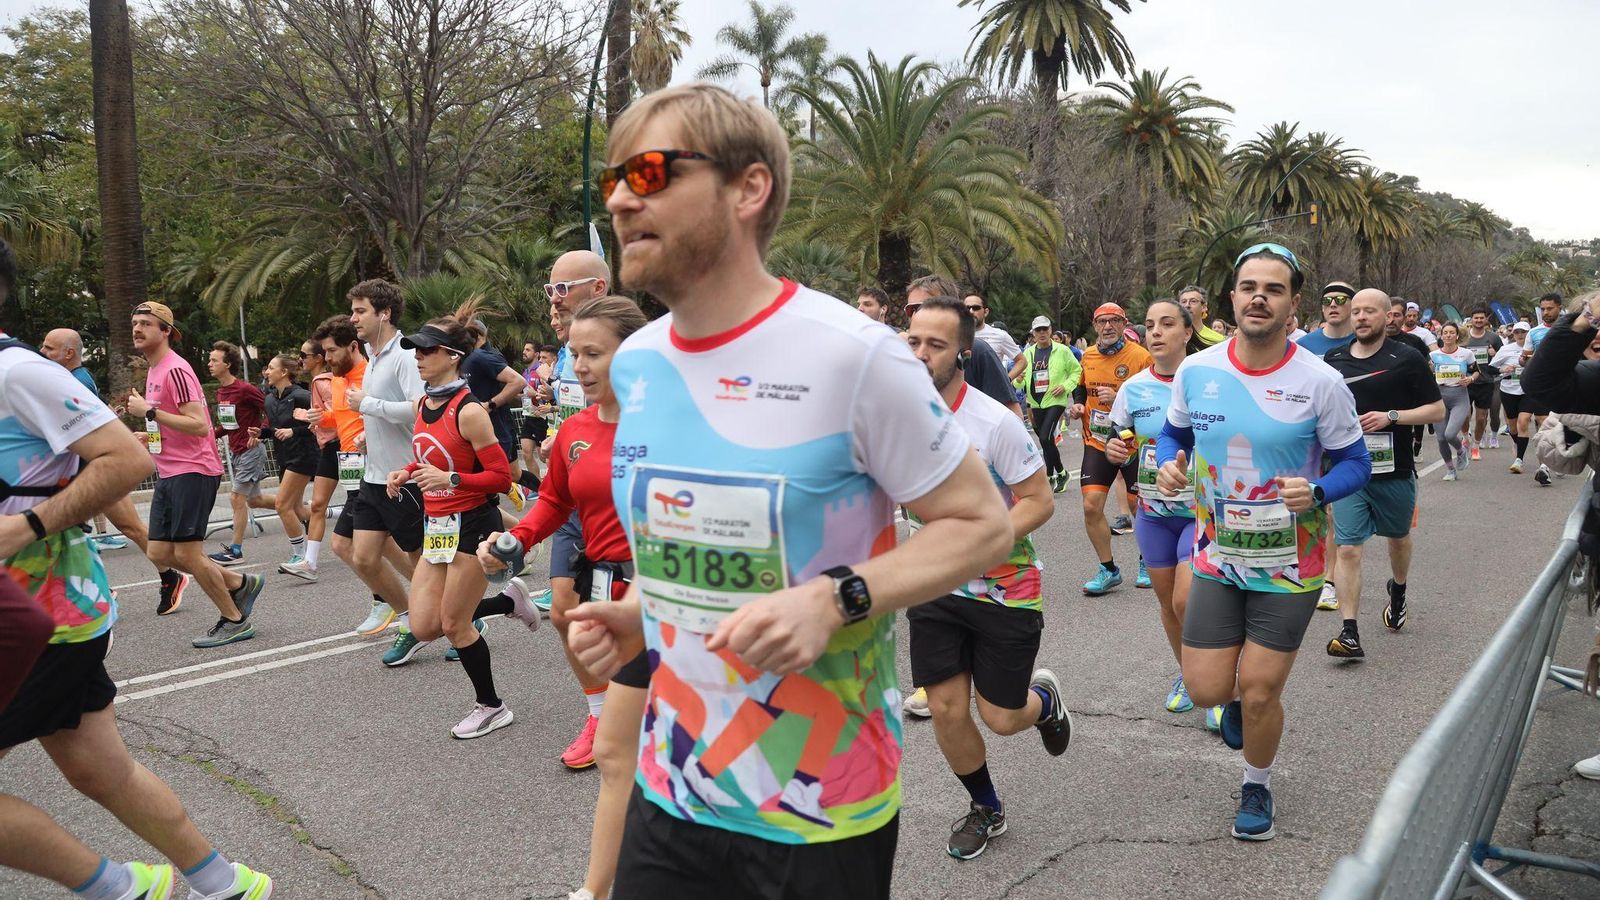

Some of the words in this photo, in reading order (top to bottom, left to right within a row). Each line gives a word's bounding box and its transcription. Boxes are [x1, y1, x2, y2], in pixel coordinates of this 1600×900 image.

[755, 391, 765, 399] DE
[429, 536, 454, 550] 3618
[1231, 530, 1284, 548] 4732
[663, 542, 755, 589] 5183
